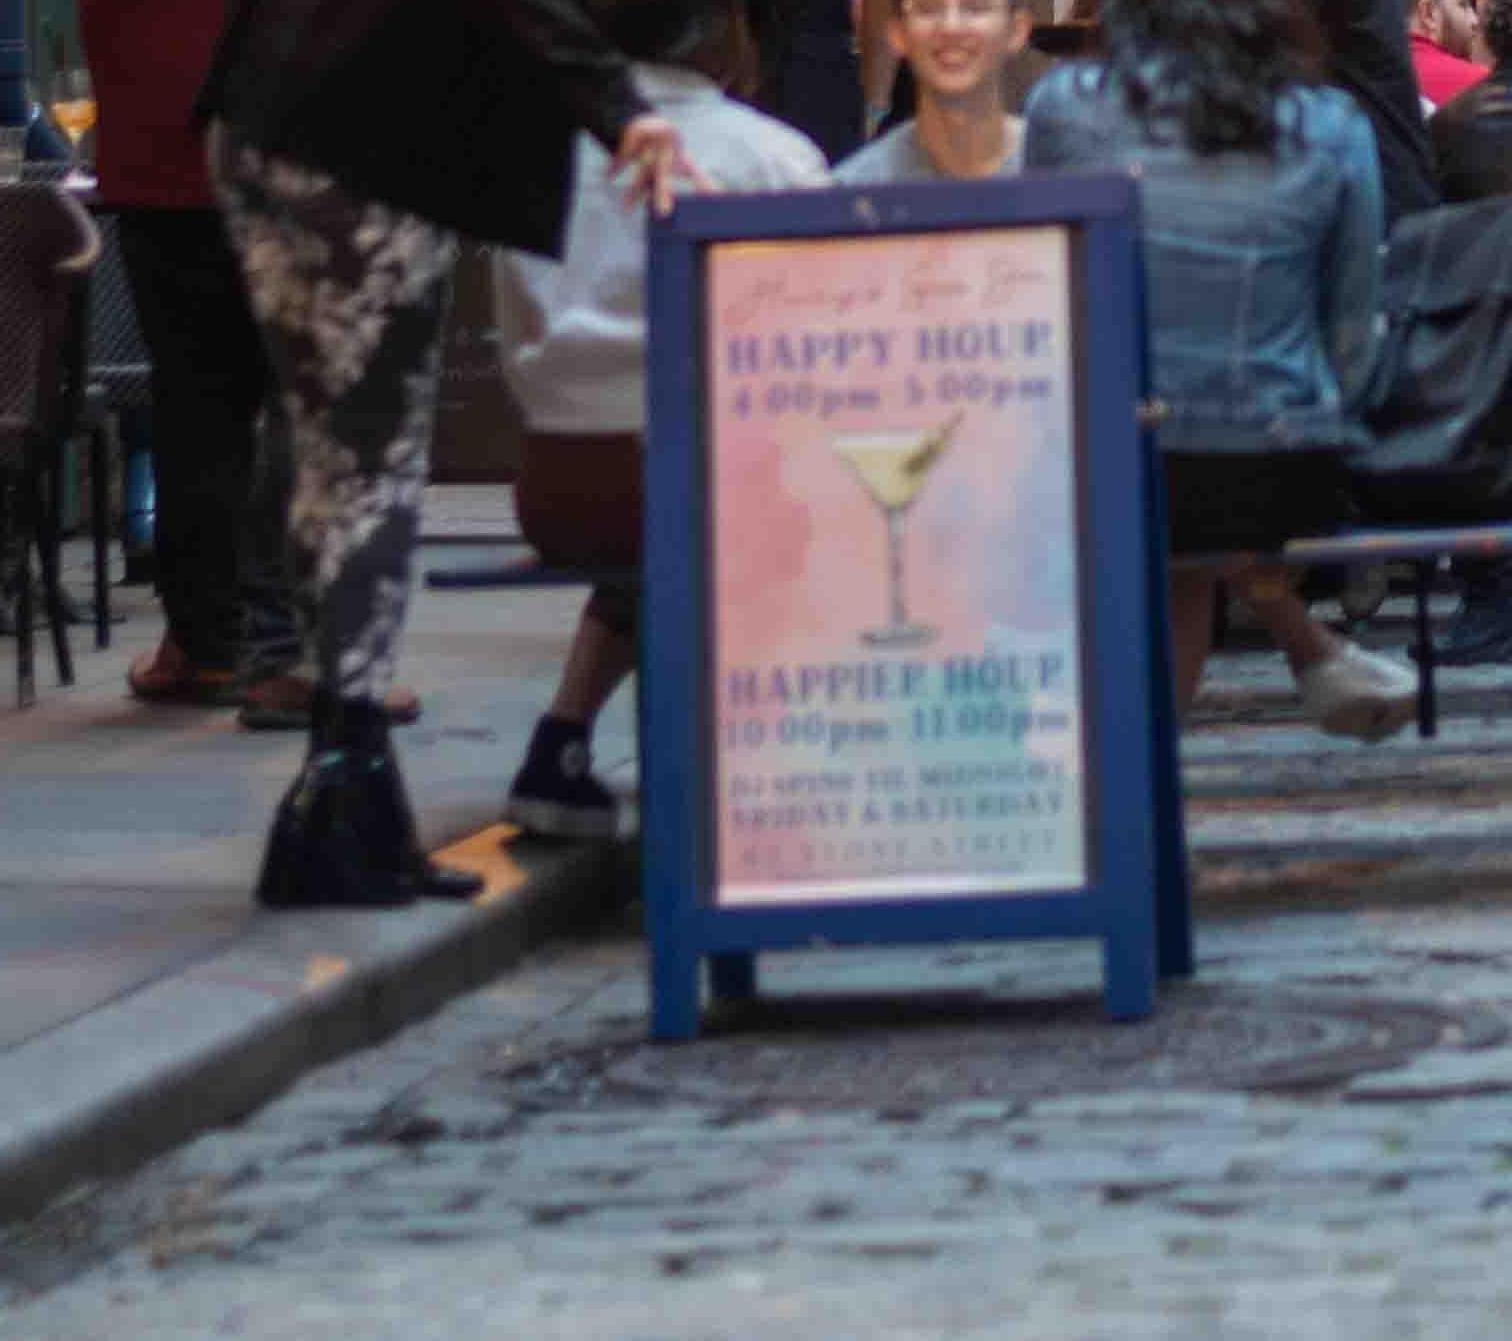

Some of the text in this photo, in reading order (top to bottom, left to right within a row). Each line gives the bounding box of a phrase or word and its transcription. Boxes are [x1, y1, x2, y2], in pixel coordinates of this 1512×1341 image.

[728, 320, 1053, 375] HAPPY HOUR
[728, 650, 1065, 708] HAPPIER HOUR
